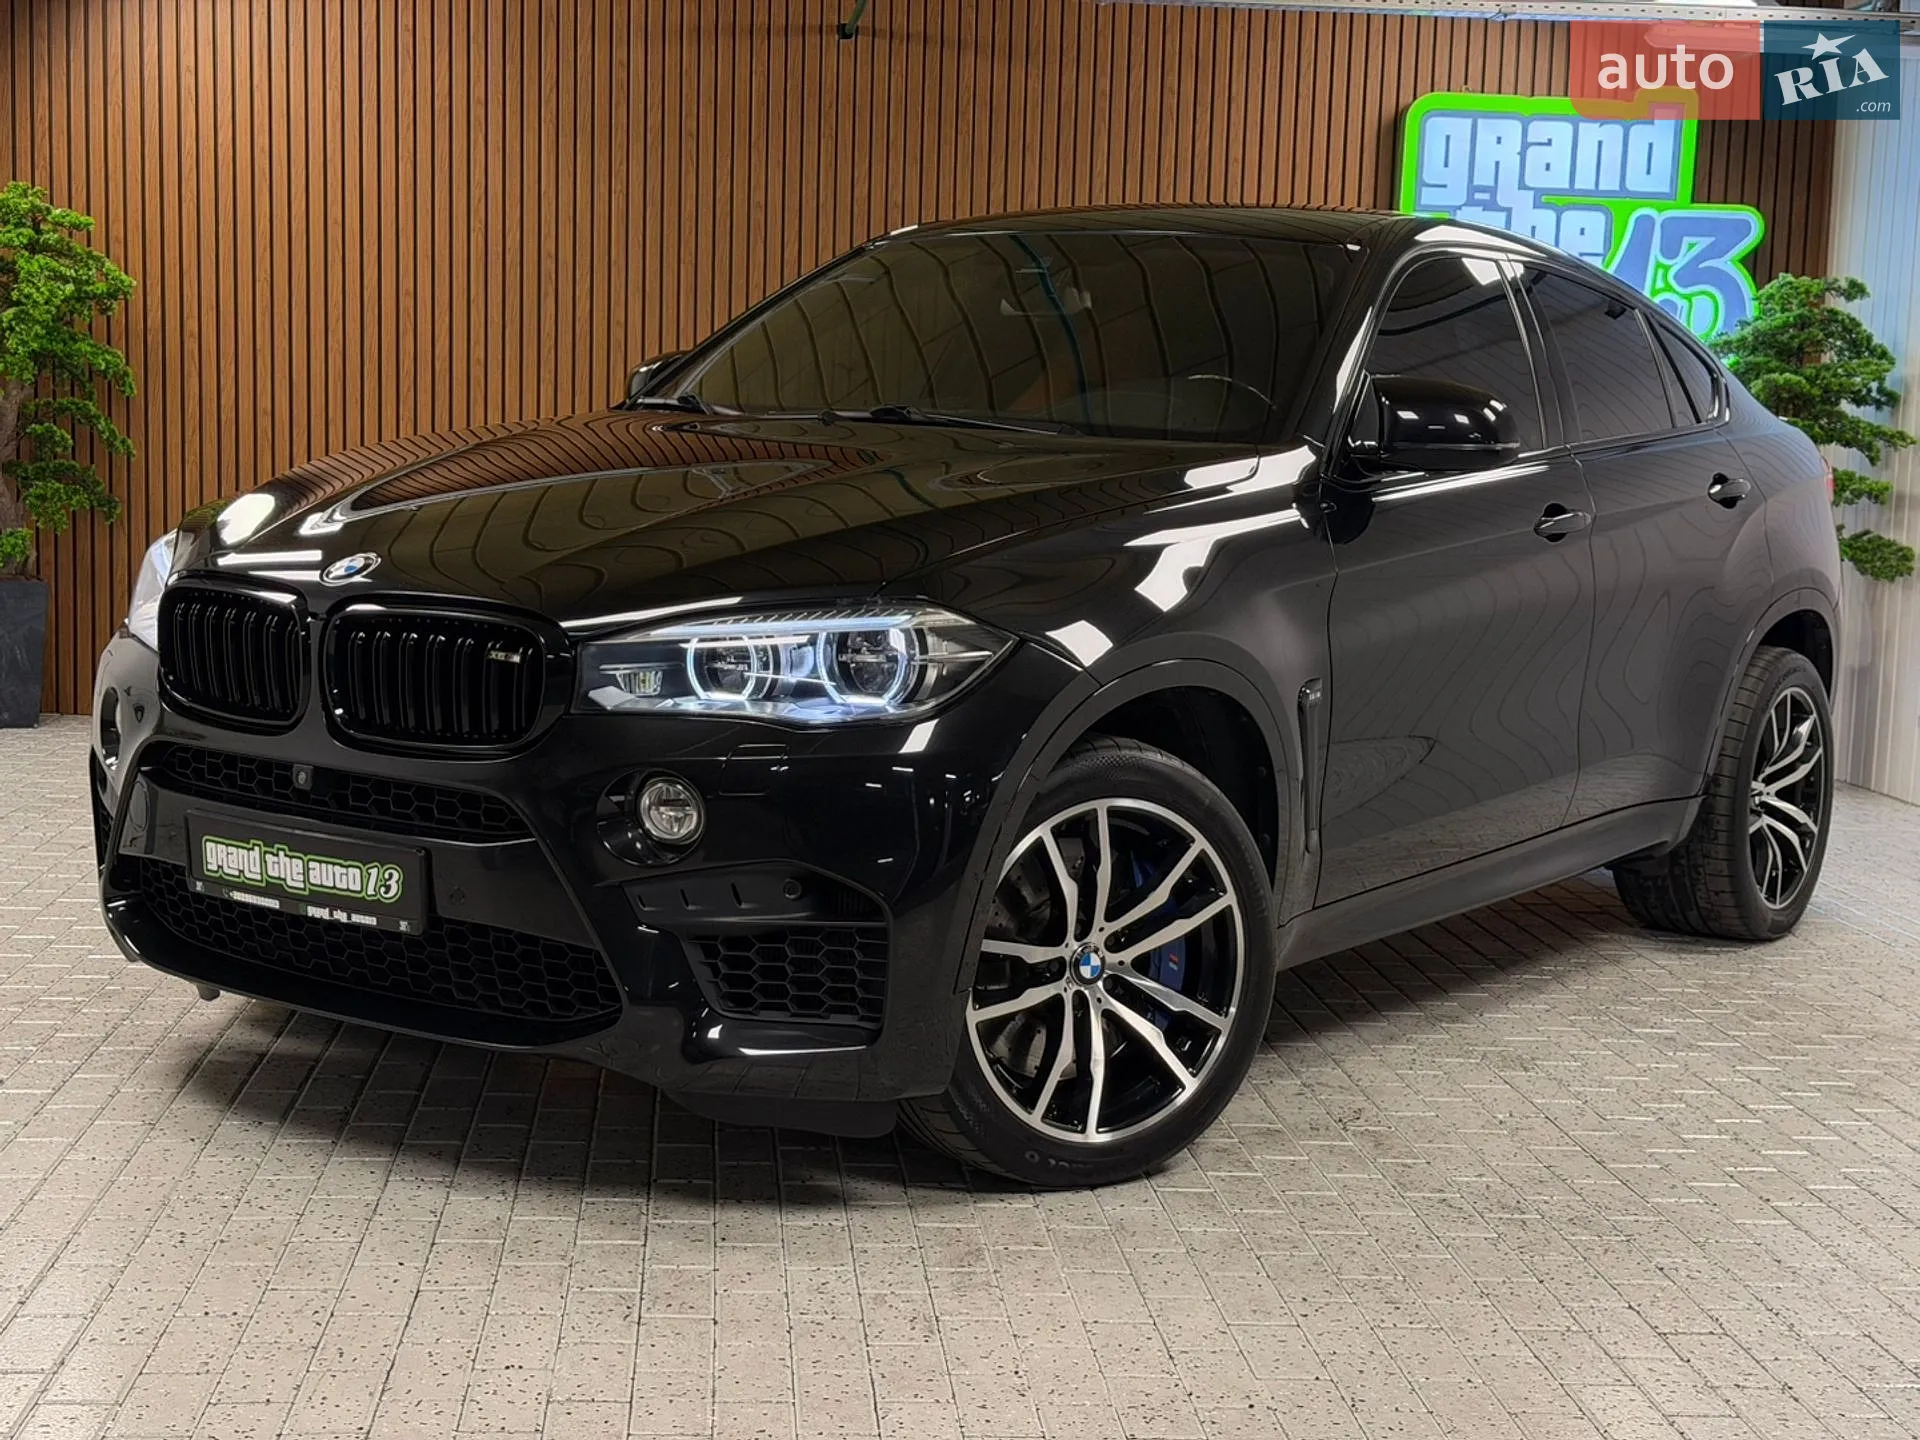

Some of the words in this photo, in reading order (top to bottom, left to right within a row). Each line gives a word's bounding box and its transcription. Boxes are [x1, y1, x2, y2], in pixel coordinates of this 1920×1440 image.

[205, 841, 263, 881] grand
[265, 850, 305, 888] the
[308, 861, 362, 892] auto
